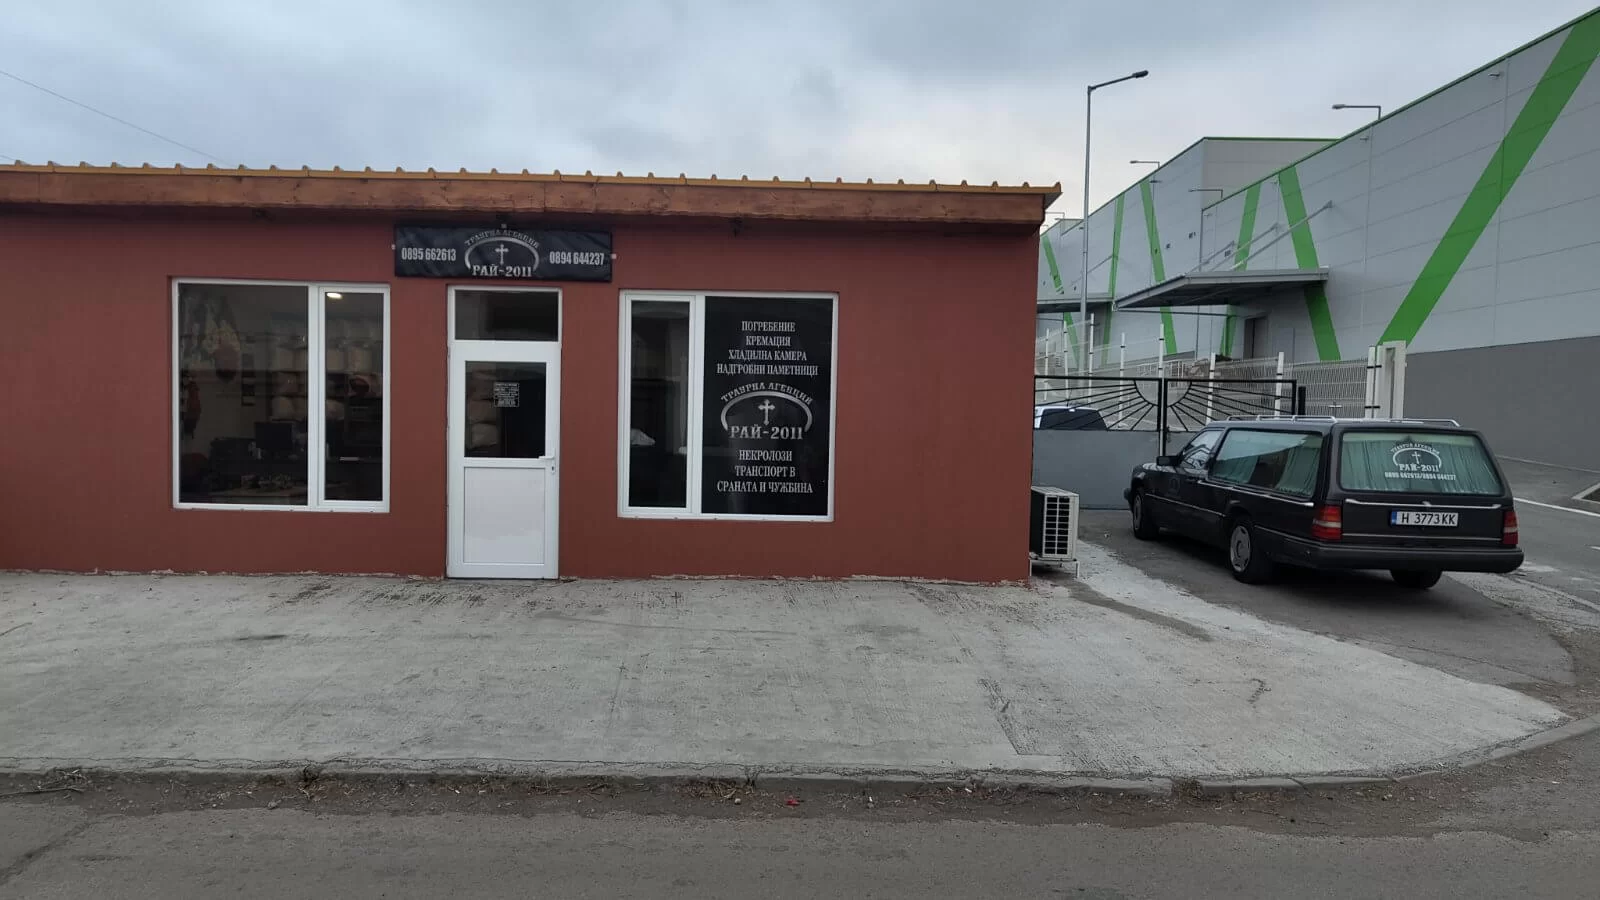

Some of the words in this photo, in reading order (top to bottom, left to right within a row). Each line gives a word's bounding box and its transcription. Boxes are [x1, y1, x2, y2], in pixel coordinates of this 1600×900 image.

[401, 248, 424, 260] 0895
[425, 248, 456, 261] 662613
[549, 251, 572, 264] 0894
[573, 252, 604, 265] 644237
[472, 264, 532, 277] РАЙ-2011
[741, 321, 796, 332] ПОГРЕБЕНИЕ
[746, 335, 791, 348] КРЕМАЦИЯ
[728, 349, 773, 361] ХЛАДИЛНА
[774, 350, 807, 361] КАМЕРА
[717, 363, 766, 376] НАДГРОБНИ
[767, 364, 819, 378] ПАМЕТНИЦИ
[720, 382, 766, 402] ТРАУРНА
[729, 424, 803, 440] РАЙ-2011
[739, 449, 793, 461] НЕКРОЛОЗИ
[734, 465, 788, 477] ТРАНСПОРТ
[789, 466, 796, 477] В
[717, 480, 758, 492] СРАНАТА
[760, 482, 766, 492] И
[768, 482, 813, 493] ЧУЖБИНА
[1401, 512, 1409, 524] H
